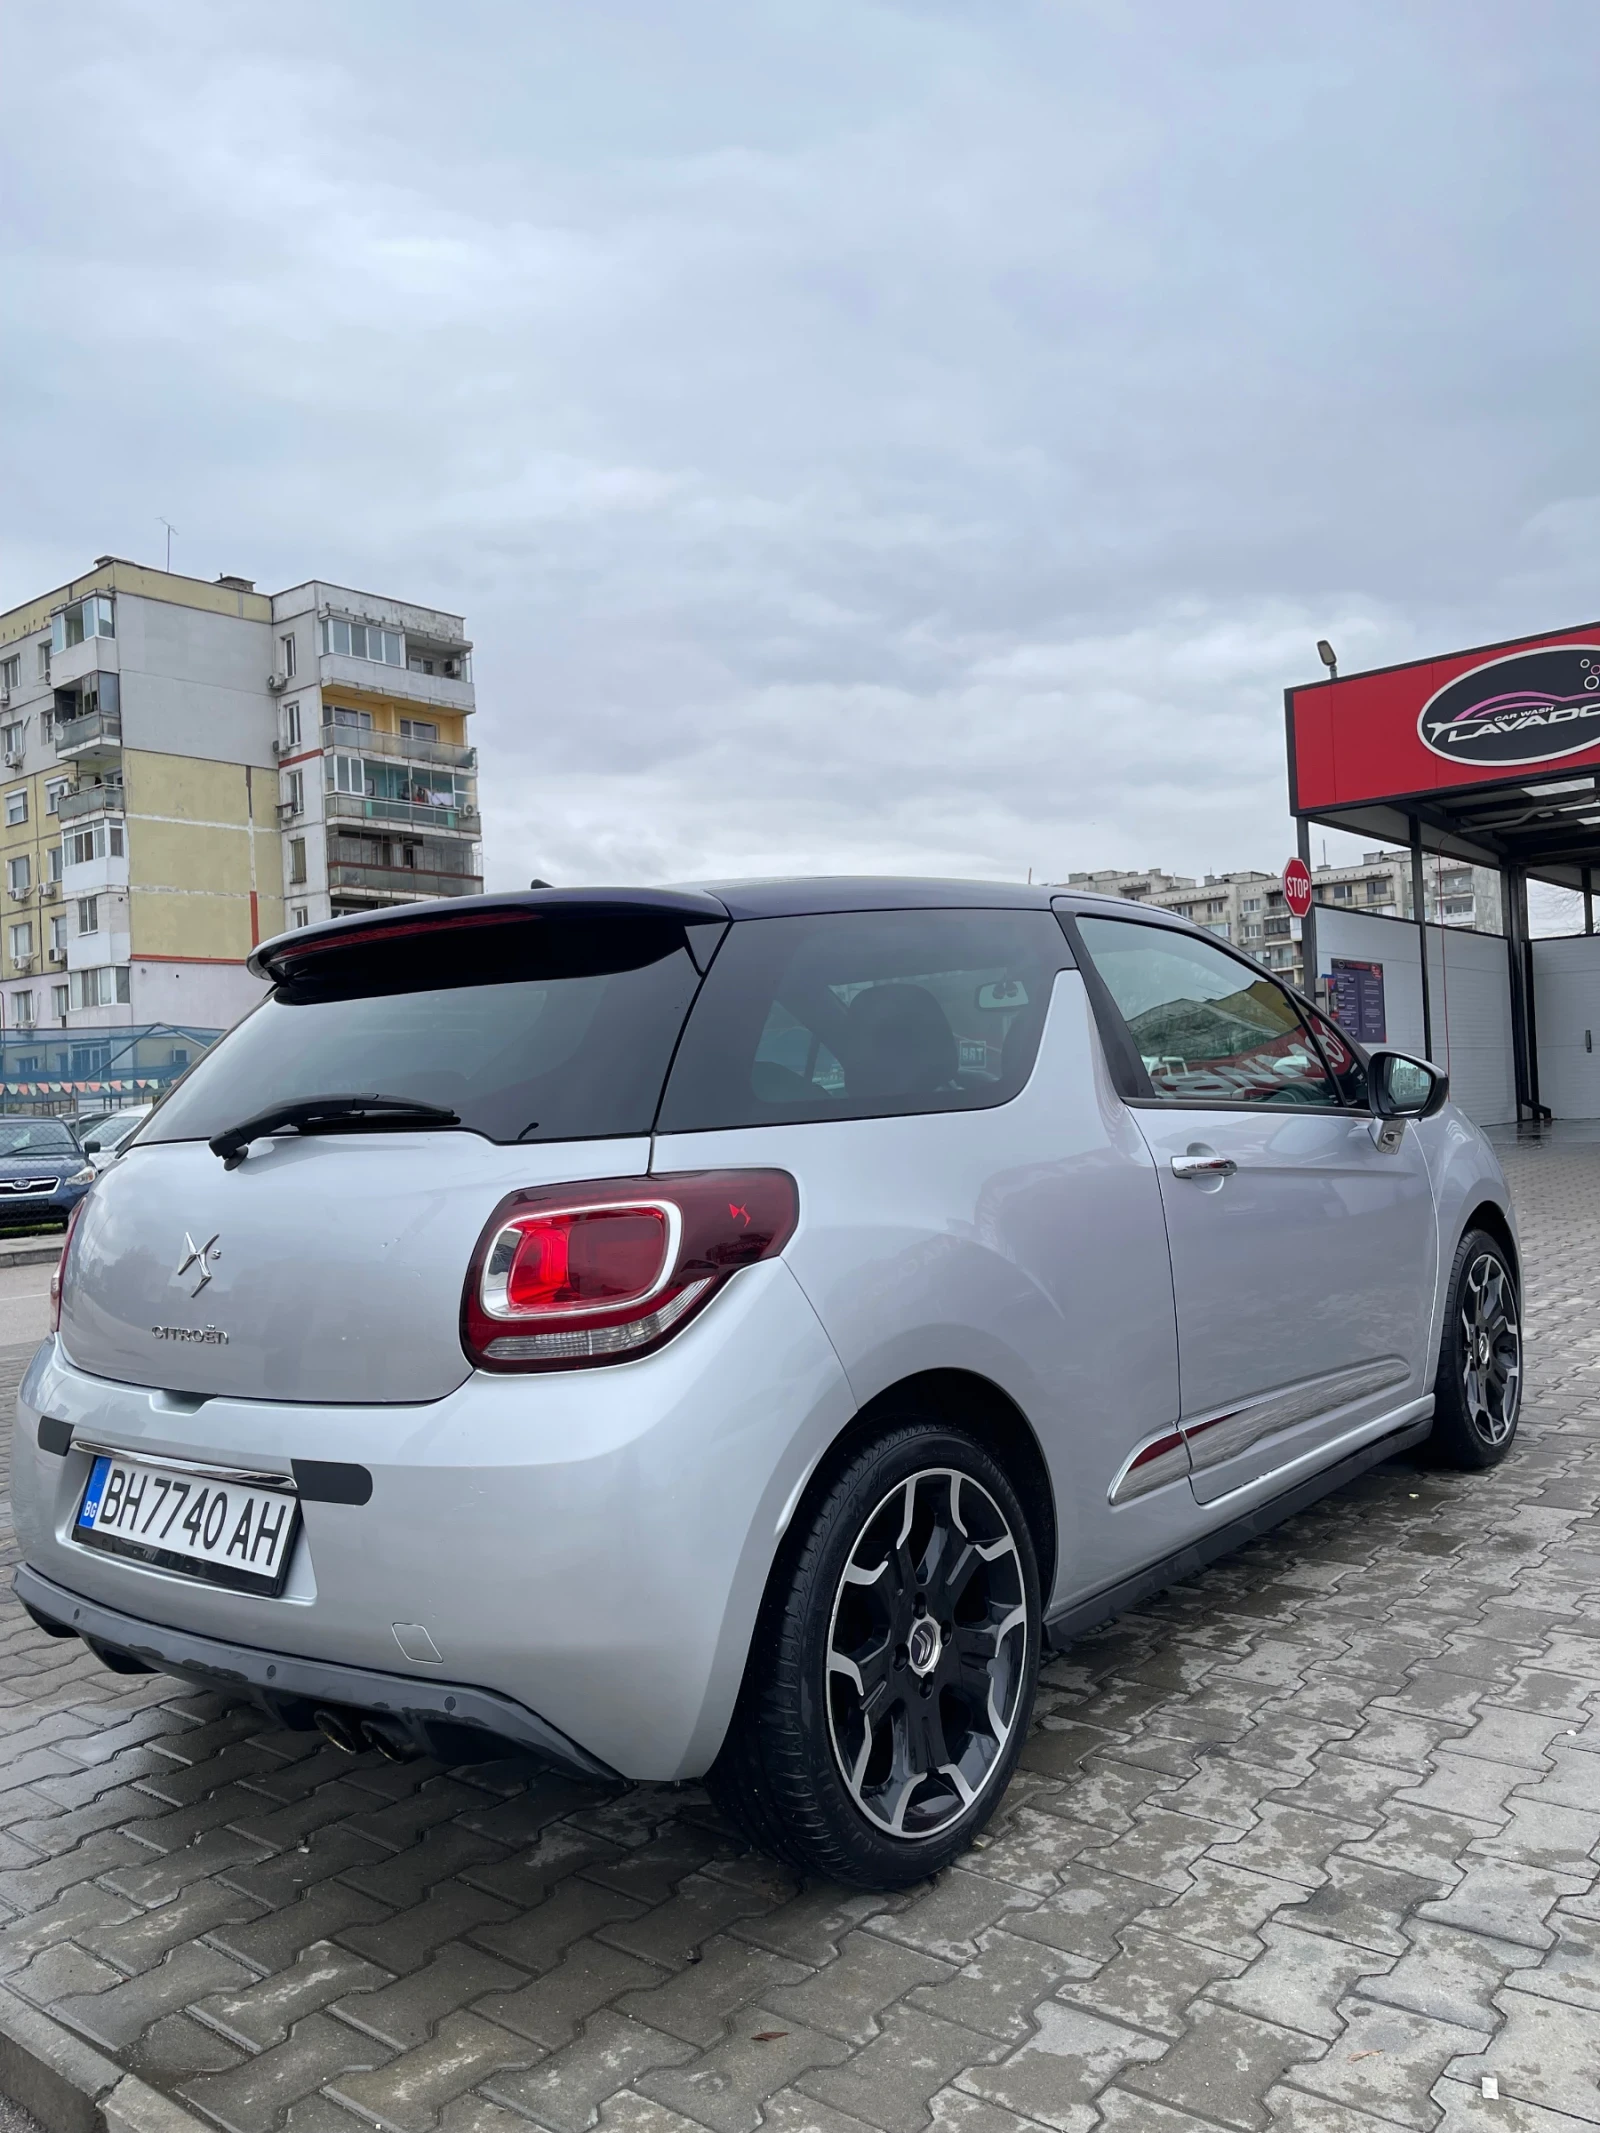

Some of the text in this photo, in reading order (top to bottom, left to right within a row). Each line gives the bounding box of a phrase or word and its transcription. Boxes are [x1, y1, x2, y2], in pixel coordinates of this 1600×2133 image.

[1494, 706, 1555, 722] CAR WASH
[1287, 876, 1309, 899] STOP
[83, 1500, 98, 1518] BG
[226, 1498, 287, 1566] AH
